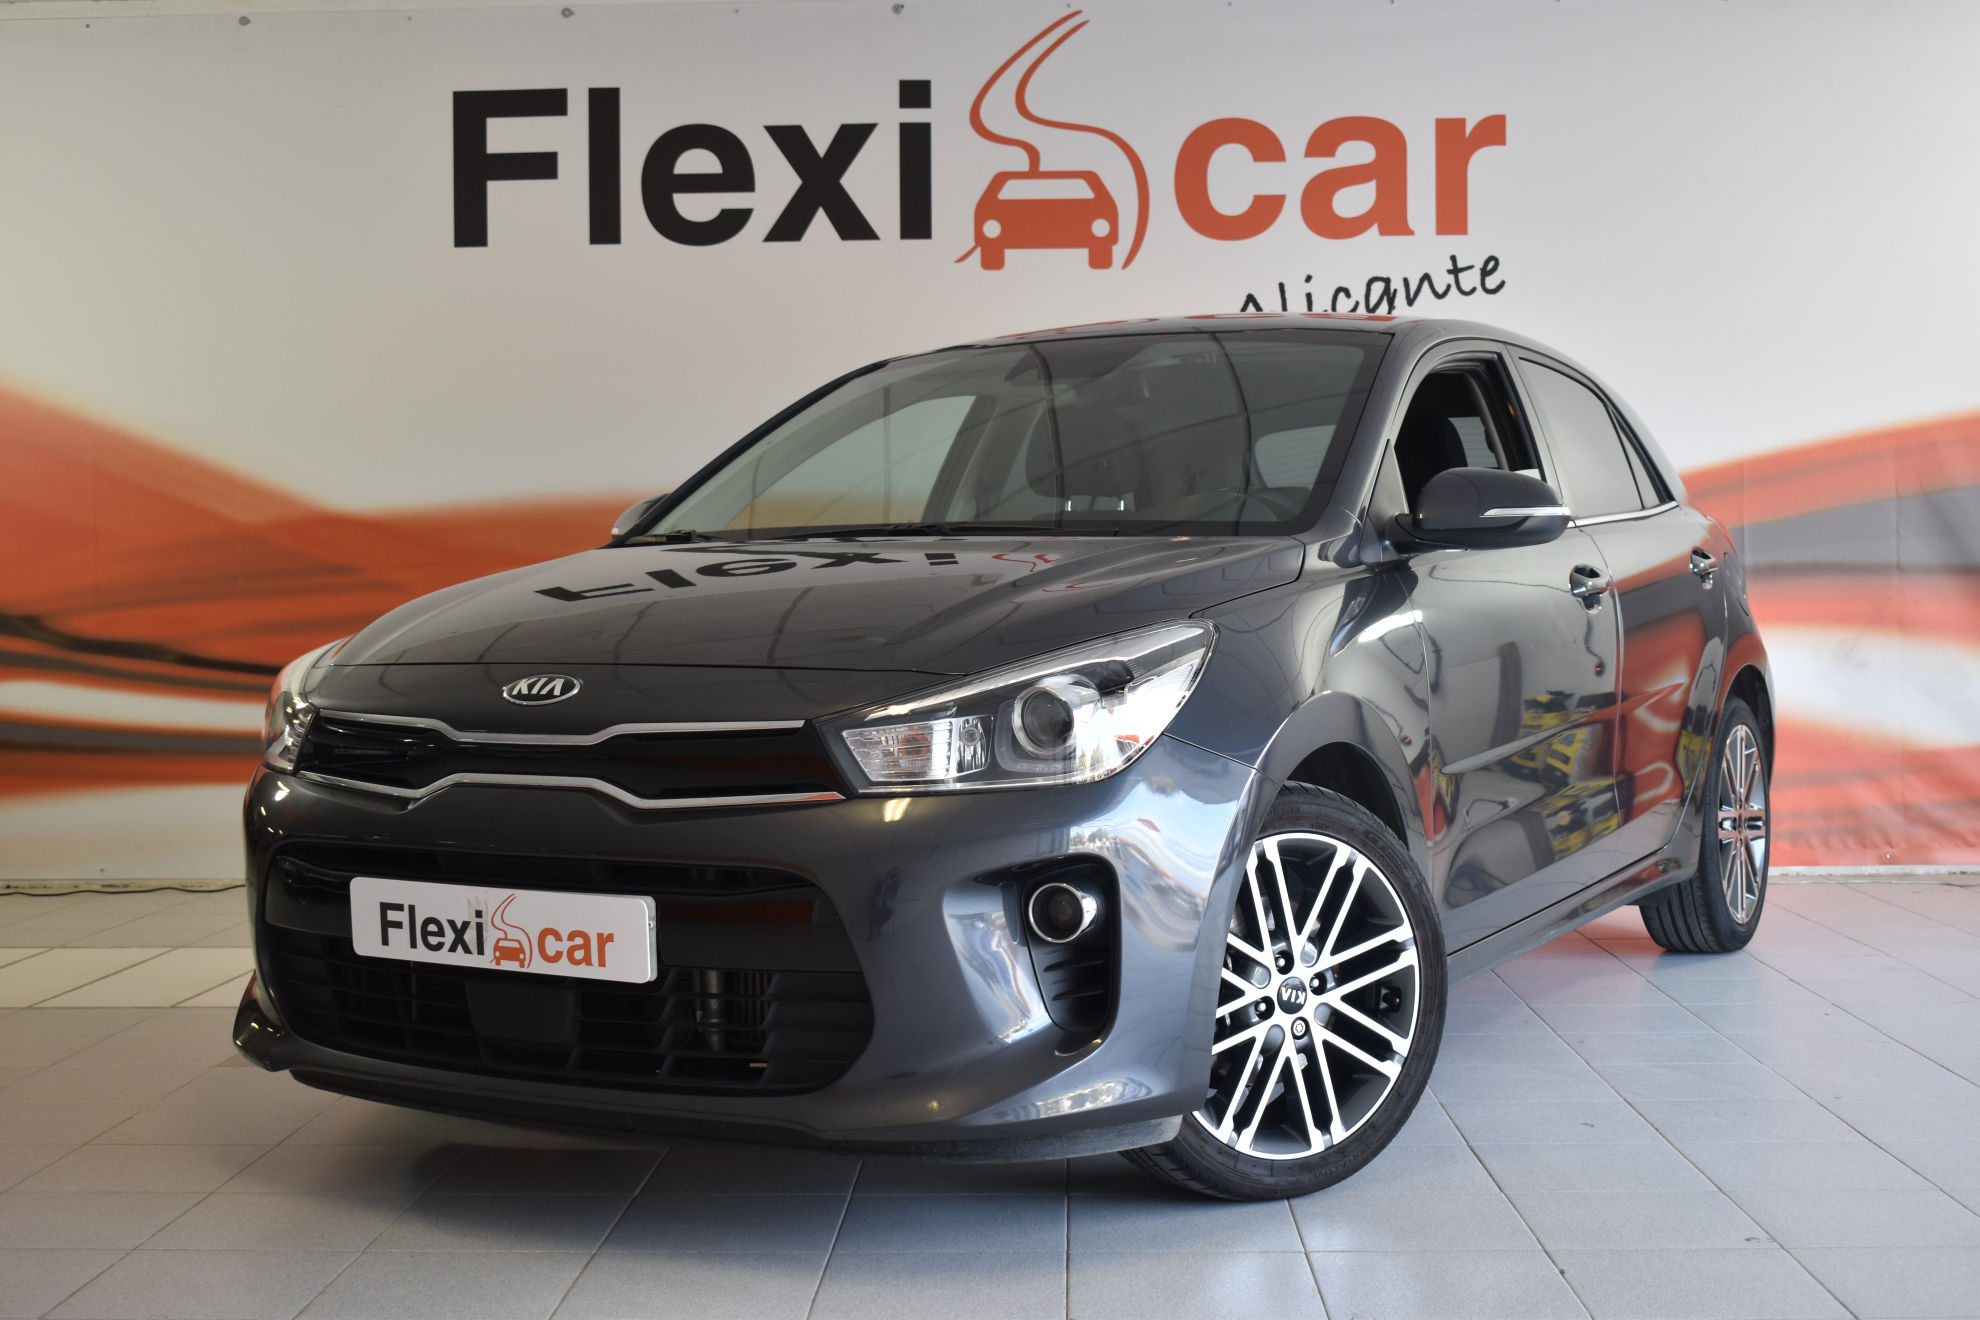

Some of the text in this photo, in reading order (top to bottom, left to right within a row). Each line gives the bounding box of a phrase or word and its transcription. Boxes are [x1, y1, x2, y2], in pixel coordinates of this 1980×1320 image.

[453, 80, 1506, 247] Flexi car
[511, 678, 565, 696] KIA
[379, 901, 614, 967] Flexi car
[1281, 987, 1306, 1005] KIA
